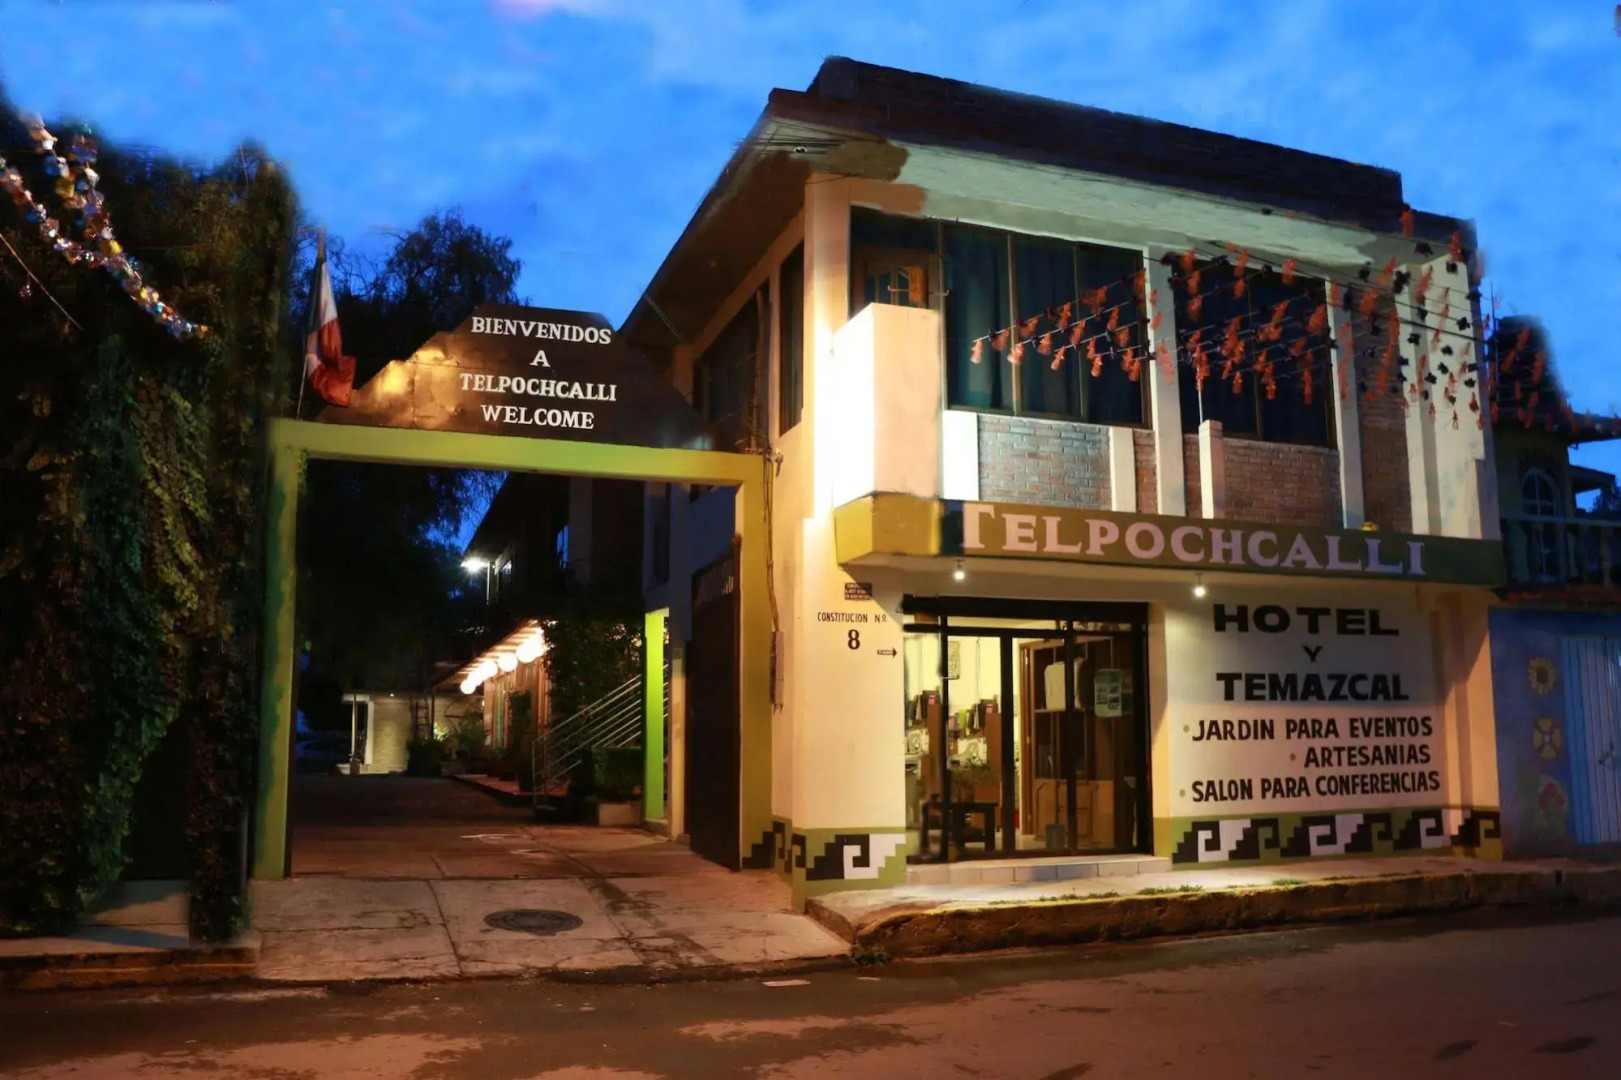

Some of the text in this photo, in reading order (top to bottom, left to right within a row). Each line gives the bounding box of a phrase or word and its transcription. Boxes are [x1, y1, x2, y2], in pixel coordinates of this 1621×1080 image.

[471, 316, 612, 345] BIENVENIDOS
[530, 350, 551, 367] A
[460, 373, 617, 401] TELPOCHCALLI
[480, 404, 594, 430] WELCOME
[963, 503, 1427, 576] TELPOCHCALLI
[817, 611, 868, 623] CONSTITUCION
[1213, 603, 1400, 636] HOTEL
[847, 629, 861, 650] 8
[1302, 645, 1323, 662] Y
[1216, 672, 1409, 701] TEMAZCAL
[1192, 716, 1433, 741] JARDIN PARA EVENTOS
[1304, 744, 1431, 768] ARTESANIAS
[1192, 771, 1440, 802] SALON PARA CONFERENCIAS
